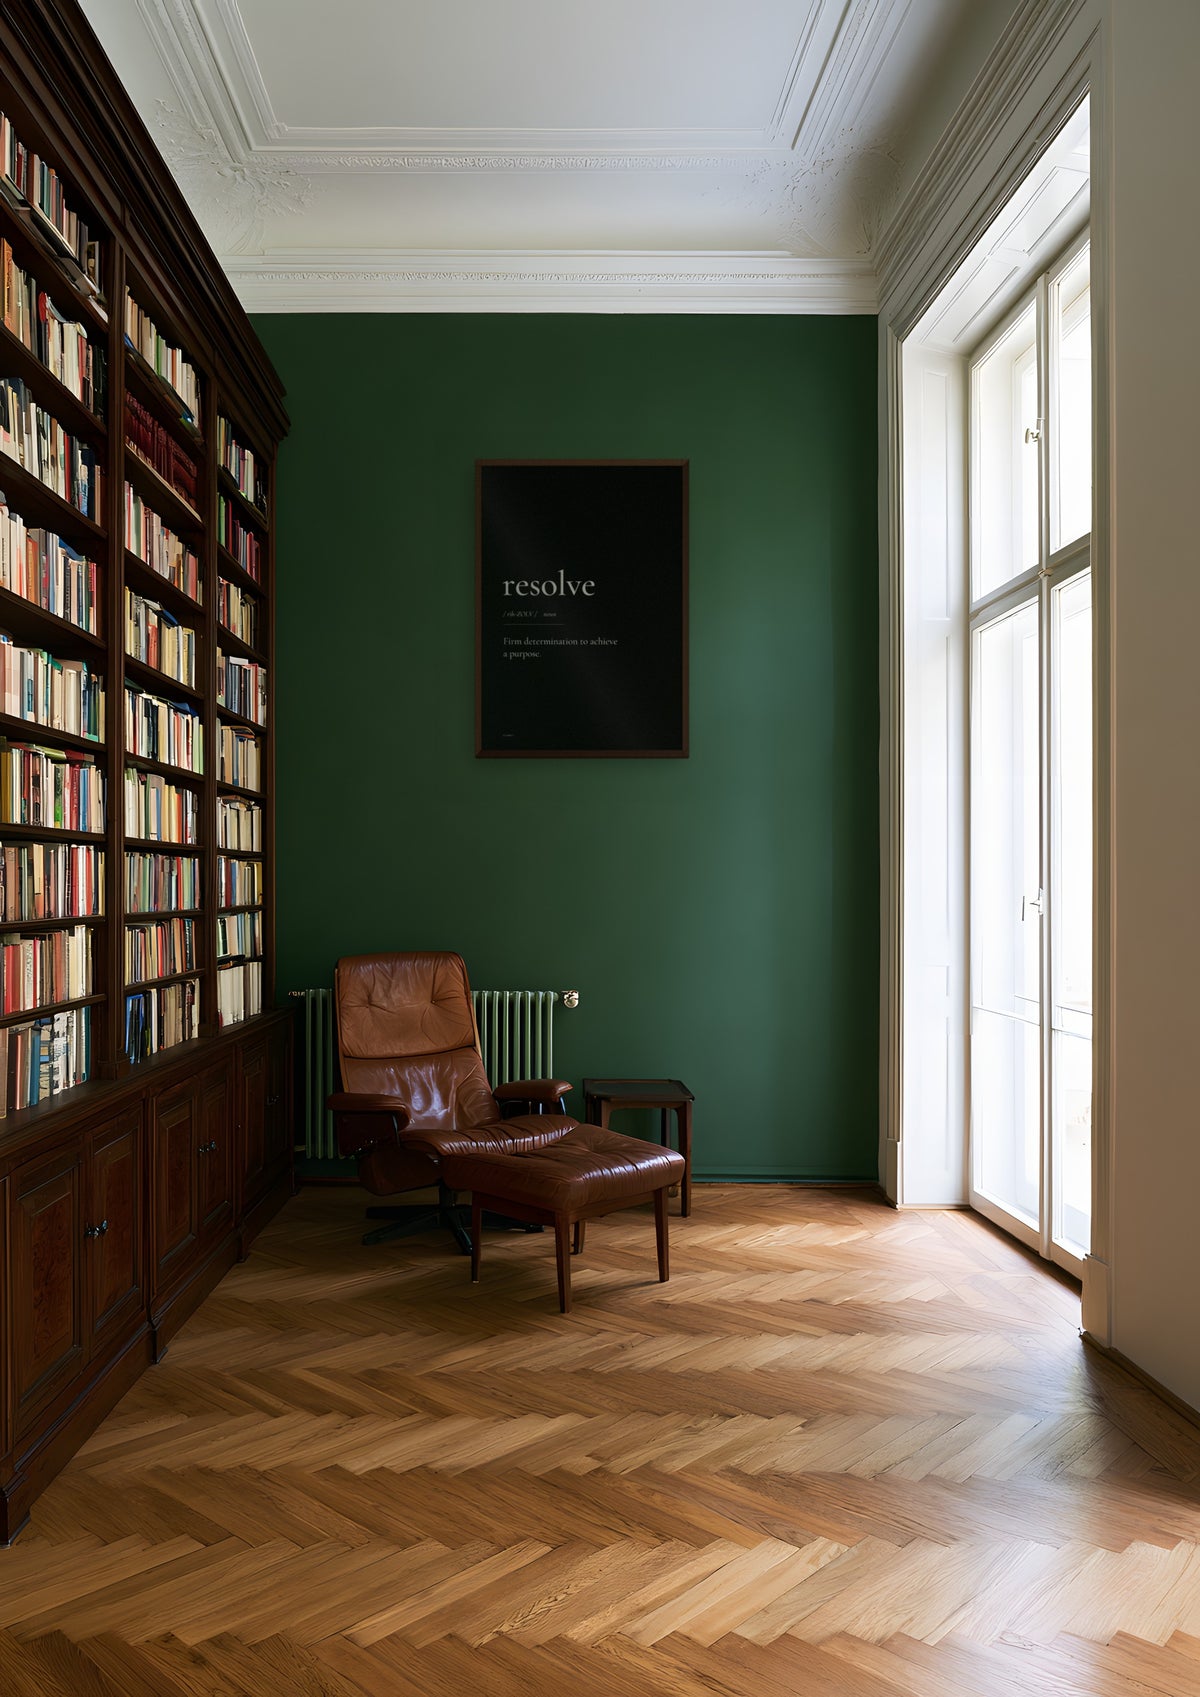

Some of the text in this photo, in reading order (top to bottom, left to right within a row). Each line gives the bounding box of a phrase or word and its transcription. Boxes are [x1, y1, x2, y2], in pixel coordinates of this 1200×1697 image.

[502, 569, 595, 596] resolve
[503, 637, 522, 645] Firm
[523, 636, 578, 645] determination
[589, 637, 618, 645] achieve
